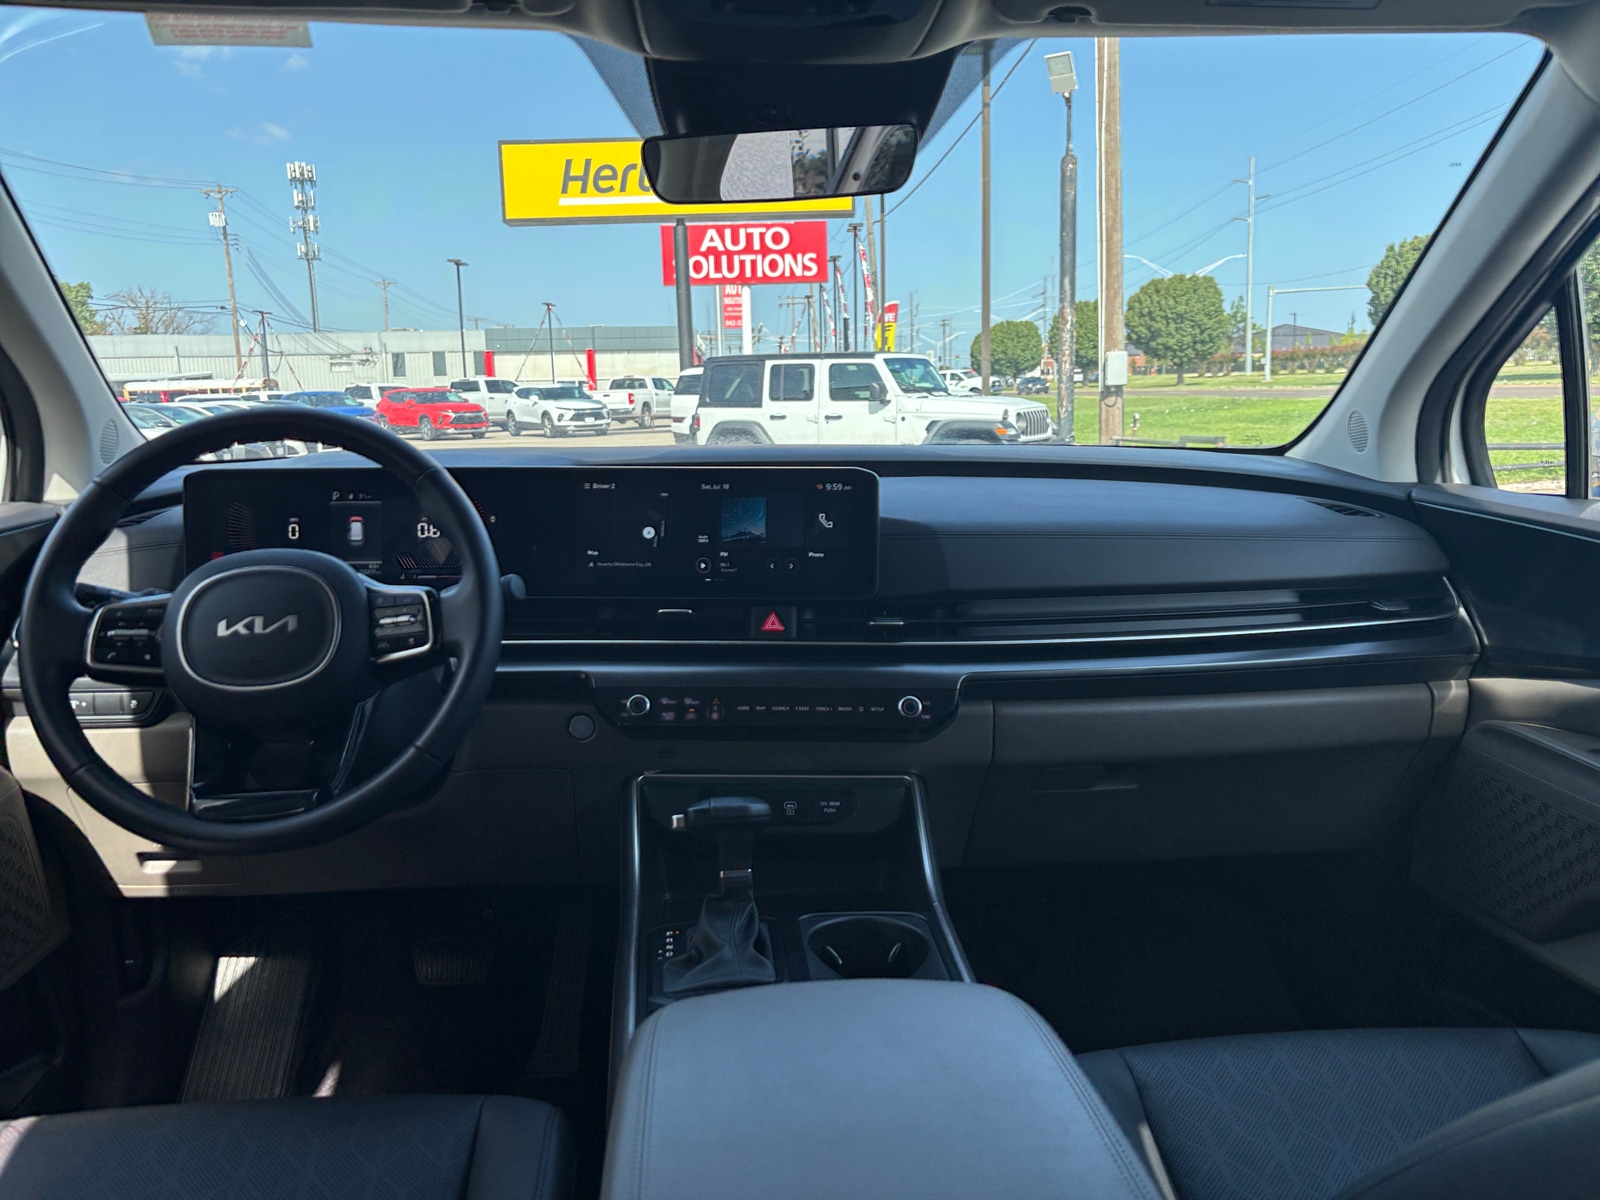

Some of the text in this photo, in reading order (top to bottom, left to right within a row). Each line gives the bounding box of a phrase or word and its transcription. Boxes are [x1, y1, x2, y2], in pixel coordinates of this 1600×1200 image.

[561, 158, 651, 194] Hert
[700, 226, 791, 252] AUTO
[673, 252, 819, 279] OLUTIONS
[725, 284, 742, 295] AUT
[332, 490, 341, 500] P
[825, 482, 843, 491] 9:59
[288, 523, 300, 540] 0
